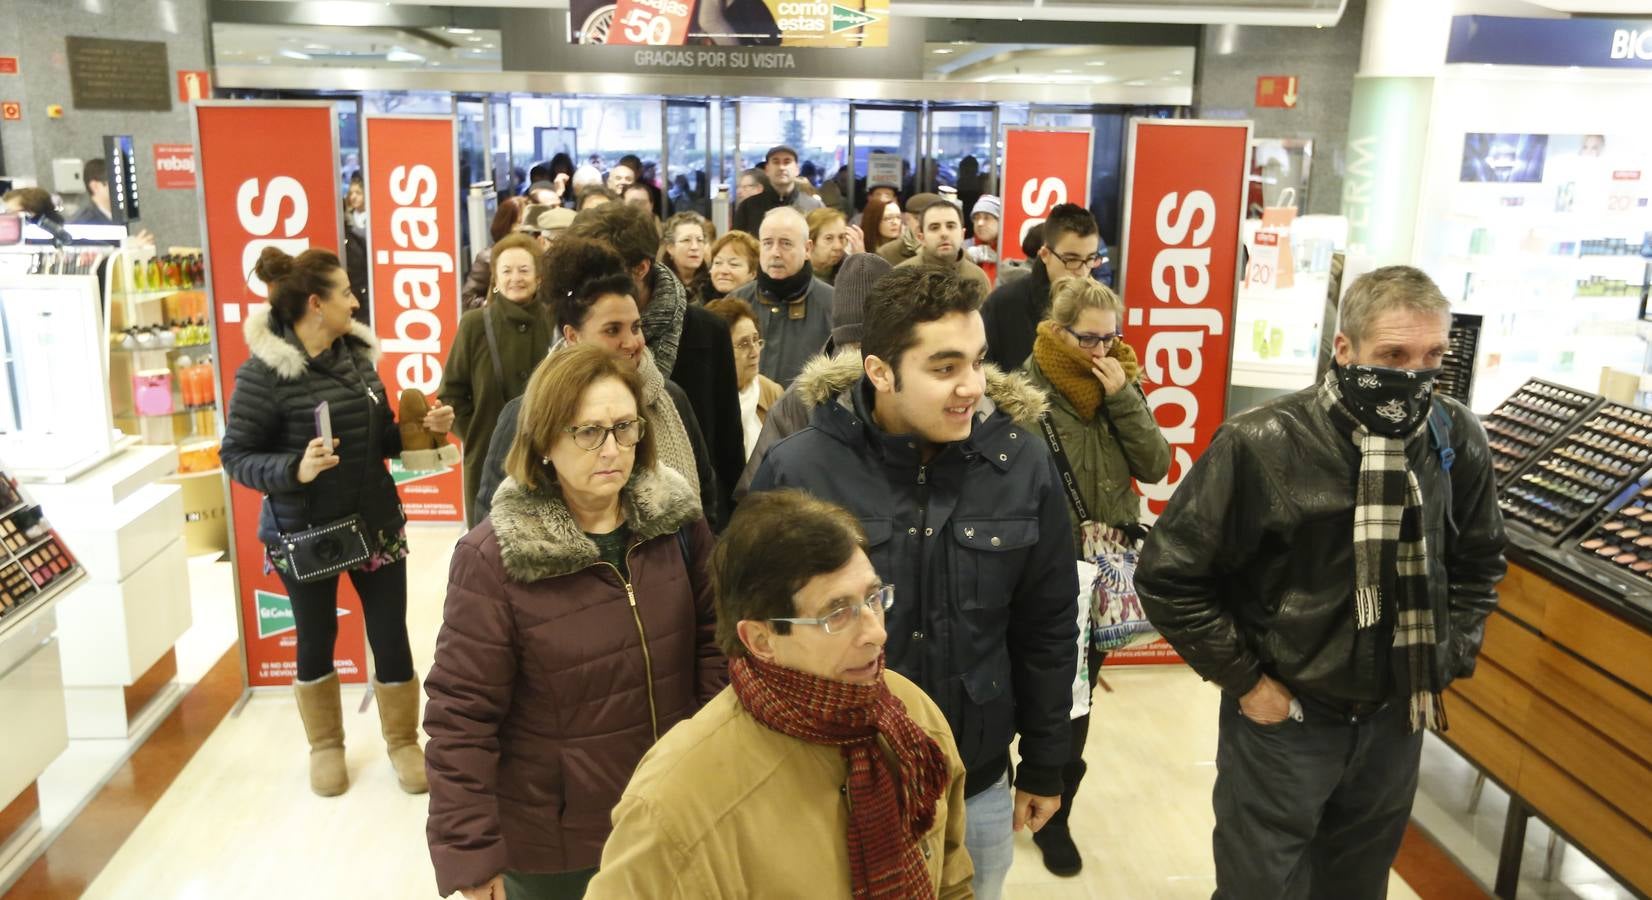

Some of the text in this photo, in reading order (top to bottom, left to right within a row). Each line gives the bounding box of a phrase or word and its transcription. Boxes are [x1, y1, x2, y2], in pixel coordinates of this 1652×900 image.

[634, 51, 795, 69] GRACIAS POR SU VISITA
[376, 164, 454, 399] ebajas
